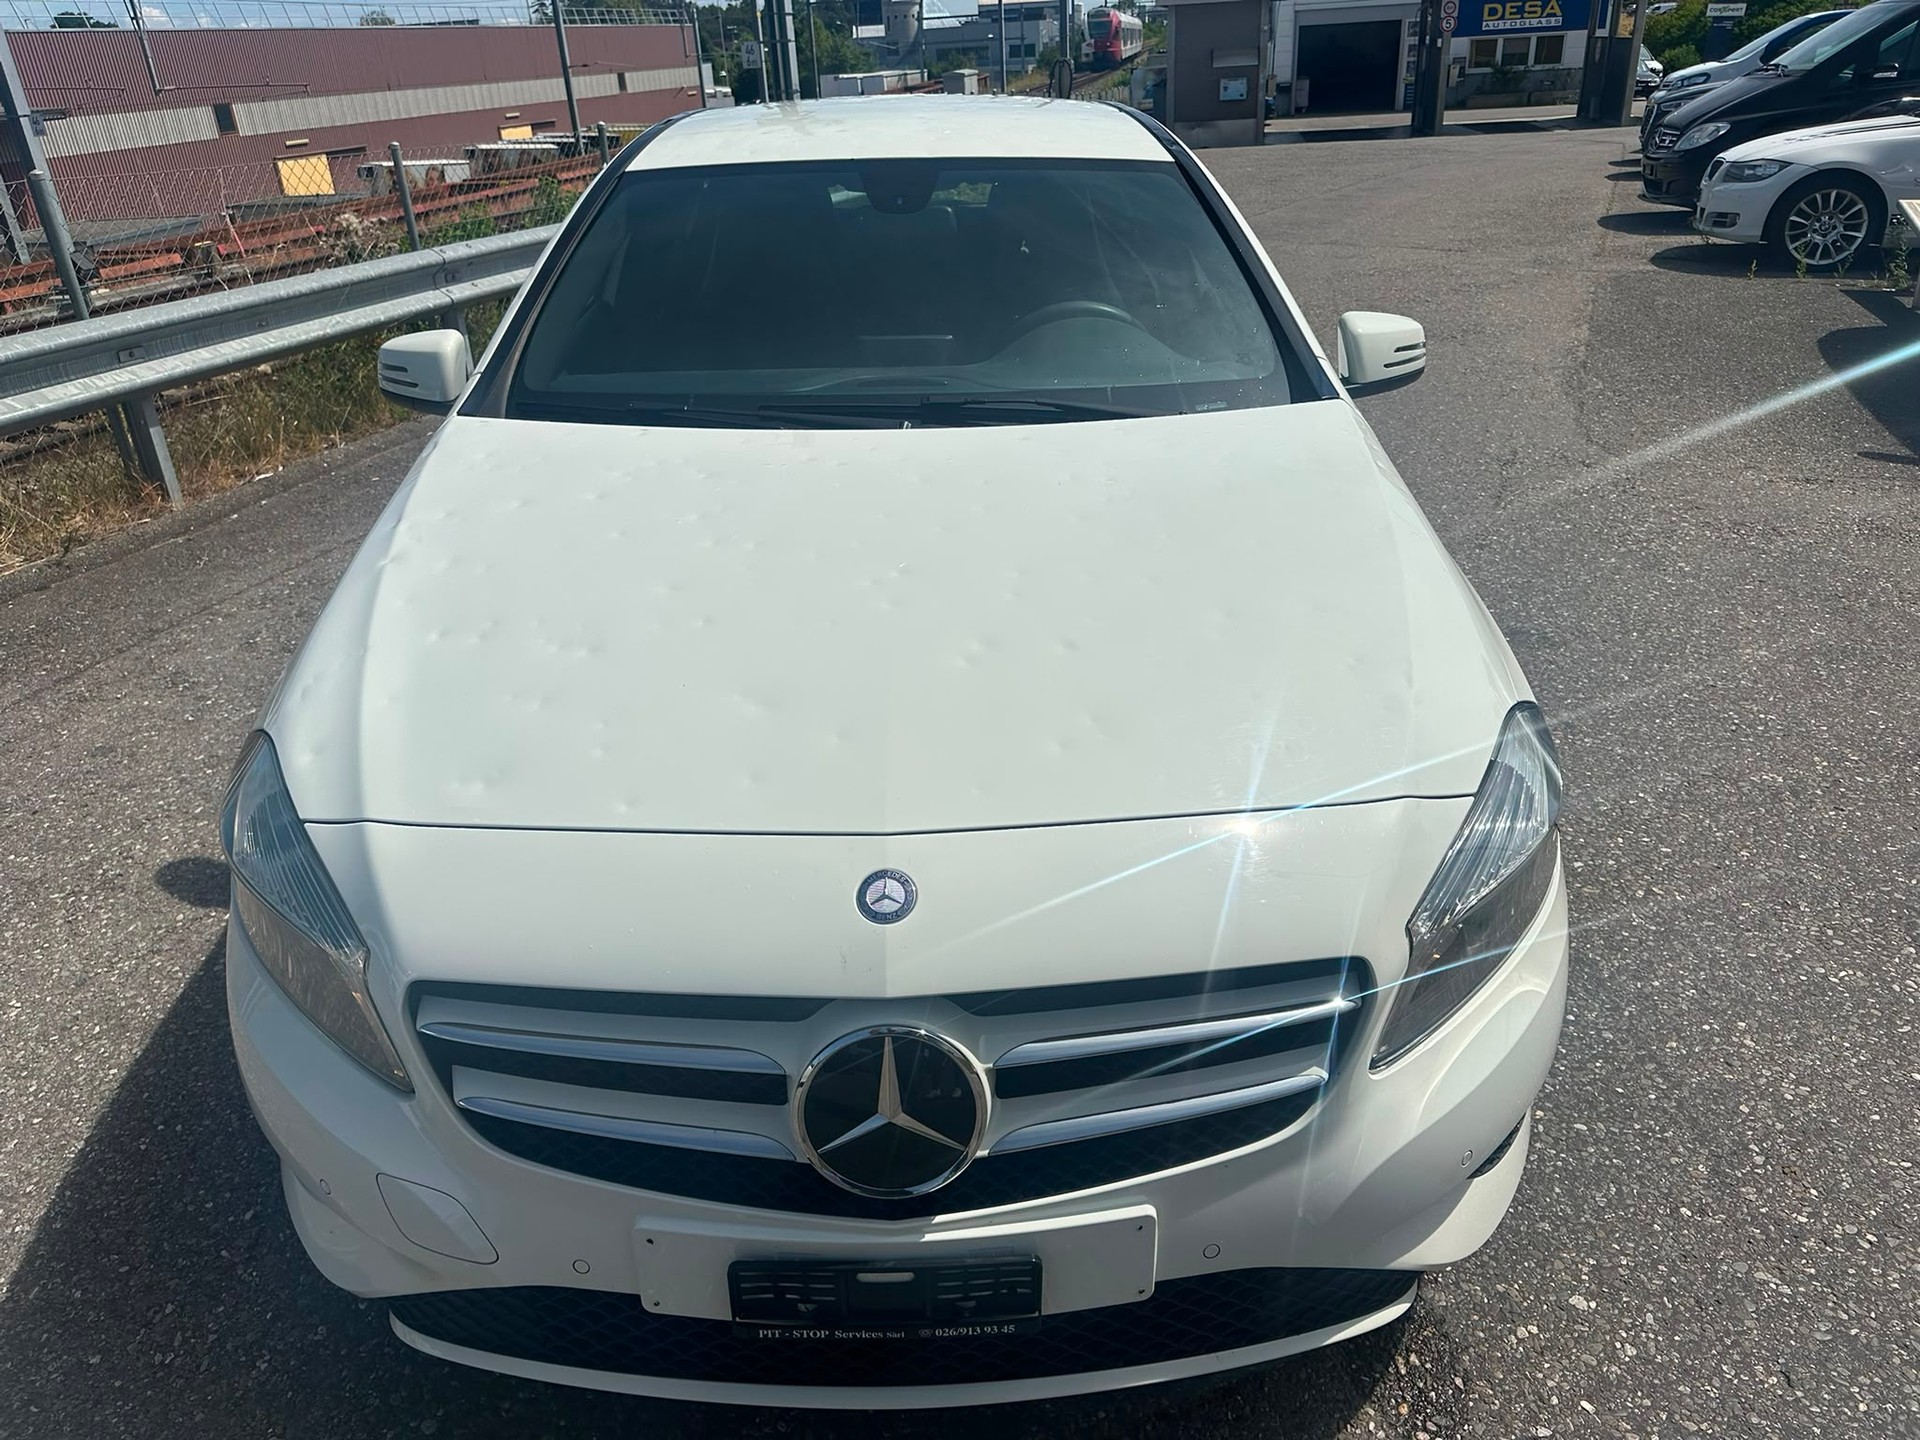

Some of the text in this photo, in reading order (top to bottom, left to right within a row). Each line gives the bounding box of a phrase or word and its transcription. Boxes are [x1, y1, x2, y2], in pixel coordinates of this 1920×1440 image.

[1482, 0, 1562, 20] DESA
[1445, 19, 1452, 29] 5
[1483, 17, 1561, 29] AUTOGLASS
[759, 1329, 782, 1338] PIT
[793, 1329, 829, 1338] STOP
[834, 1329, 884, 1338] Services
[935, 1327, 981, 1337] 026/913
[984, 1325, 998, 1334] 93
[1001, 1324, 1016, 1333] 45
